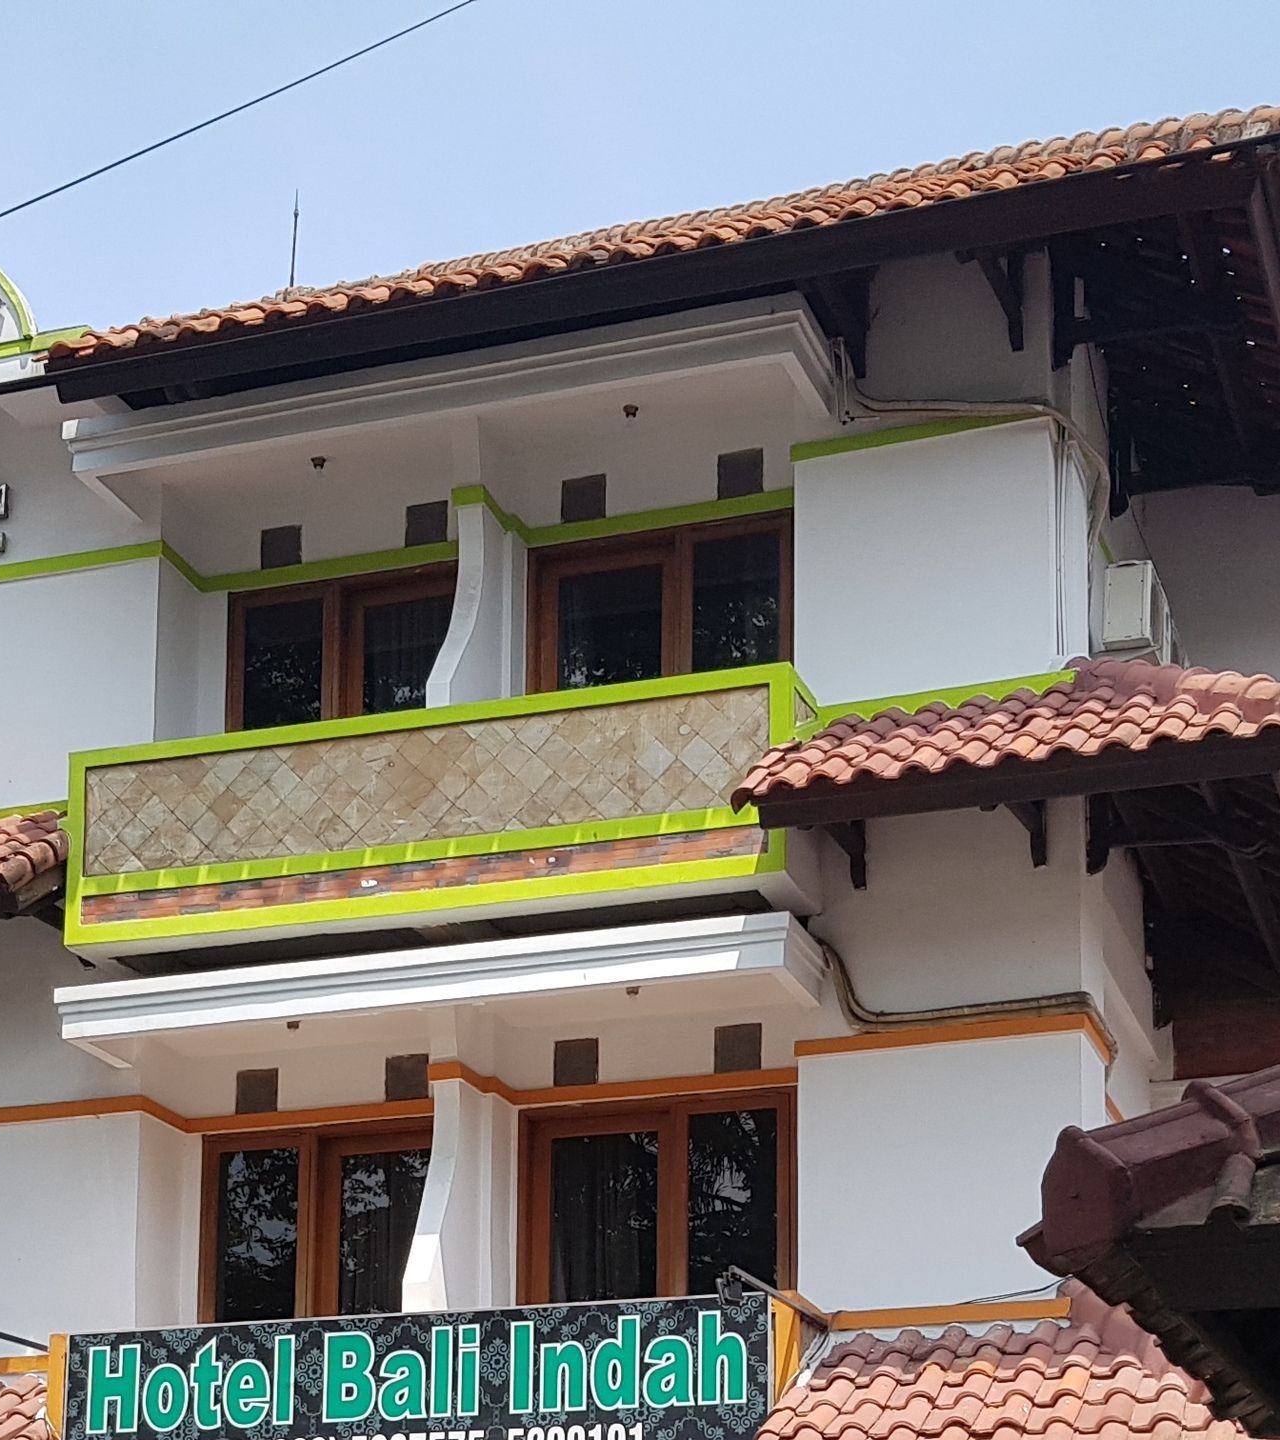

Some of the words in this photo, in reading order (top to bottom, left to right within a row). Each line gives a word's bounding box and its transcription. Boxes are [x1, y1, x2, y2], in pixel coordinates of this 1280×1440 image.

[84, 1332, 295, 1434] Hotel
[320, 1322, 481, 1425] Bali
[508, 1308, 750, 1416] Indah
